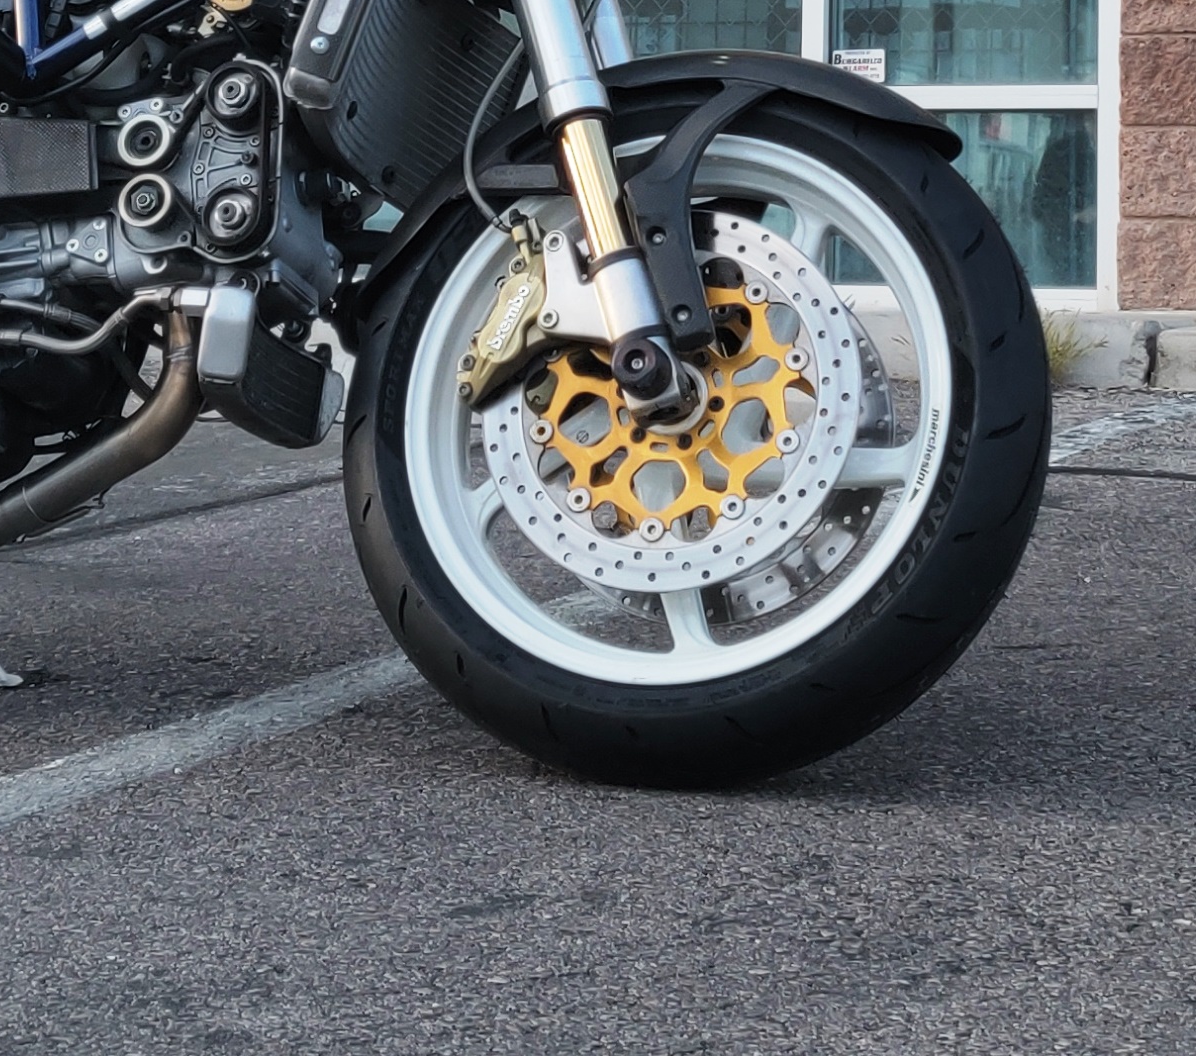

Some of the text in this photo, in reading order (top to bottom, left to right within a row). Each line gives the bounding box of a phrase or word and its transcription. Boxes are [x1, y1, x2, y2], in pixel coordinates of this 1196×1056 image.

[486, 285, 530, 351] brembo
[914, 407, 941, 488] marchesini
[871, 423, 969, 615] DUNLOP
